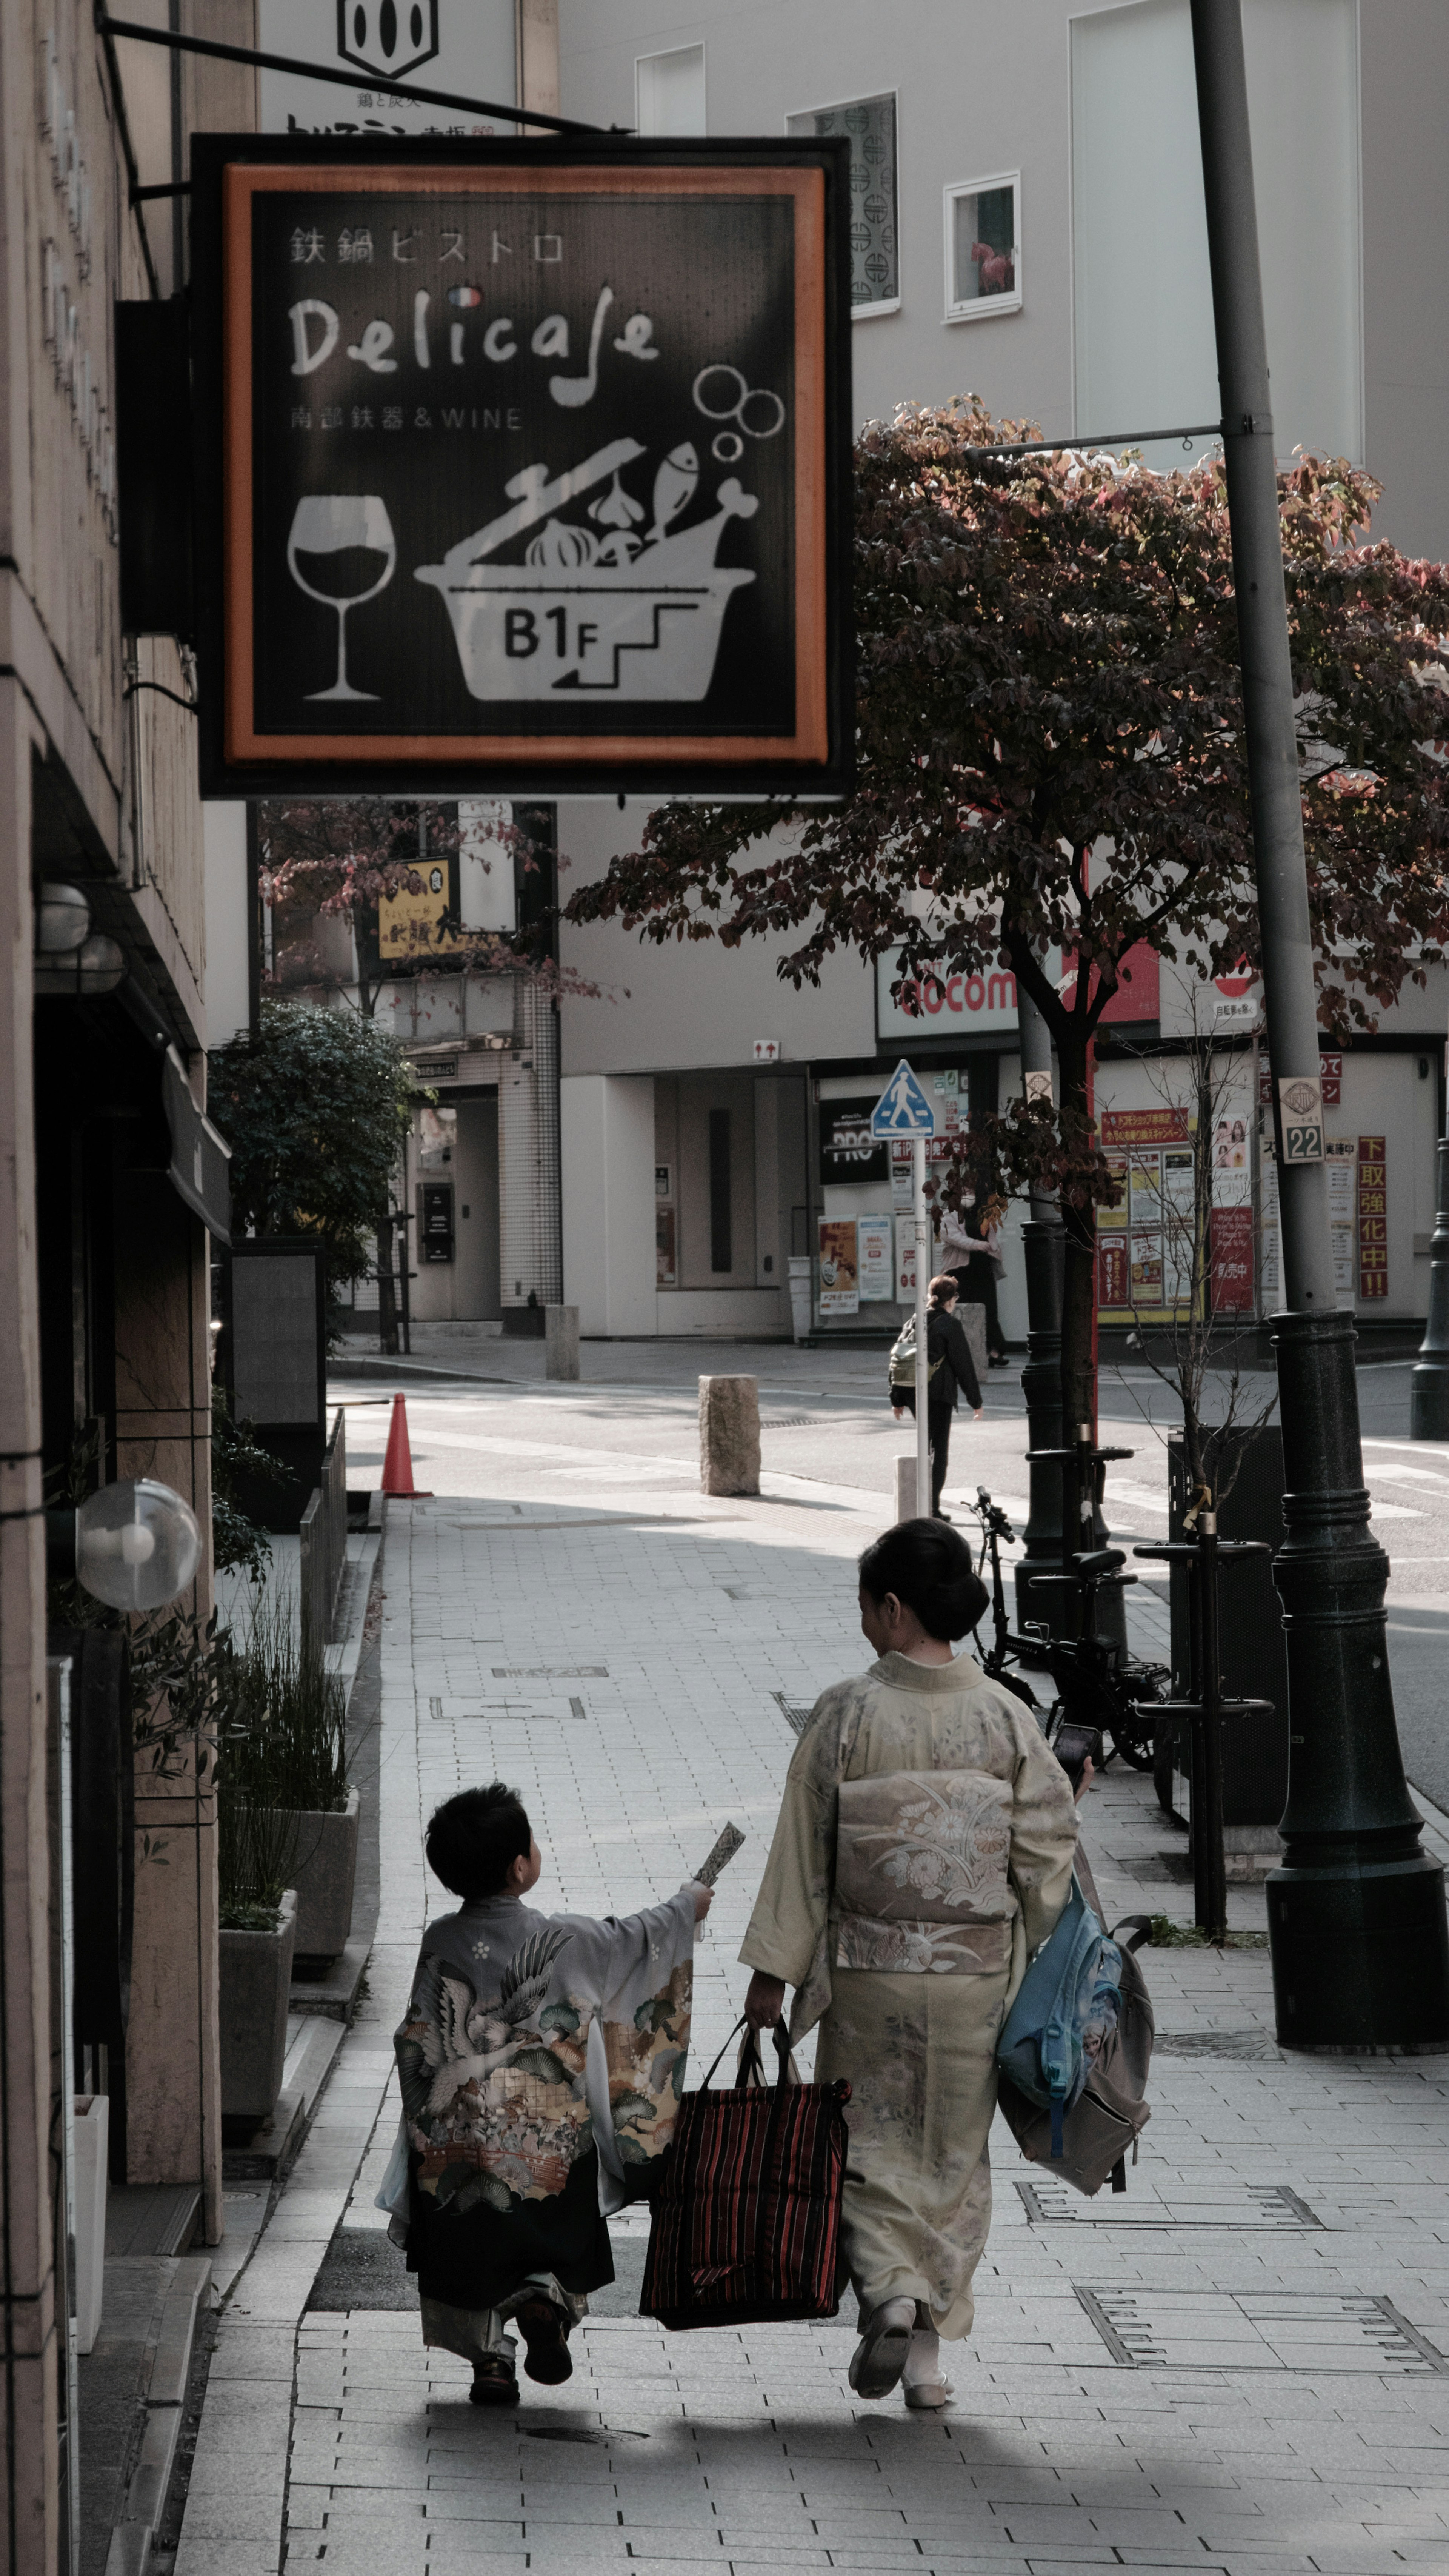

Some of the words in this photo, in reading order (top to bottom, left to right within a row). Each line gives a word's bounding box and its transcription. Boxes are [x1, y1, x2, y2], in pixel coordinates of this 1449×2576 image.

[289, 226, 563, 264] 鉄鍋ビストロ
[415, 407, 432, 428] &
[441, 407, 523, 430] WINE
[505, 605, 598, 659] B1F
[1290, 1127, 1320, 1158] 22
[1361, 1138, 1385, 1296] 下取強化中!!
[1218, 1262, 1247, 1279] 販売中
